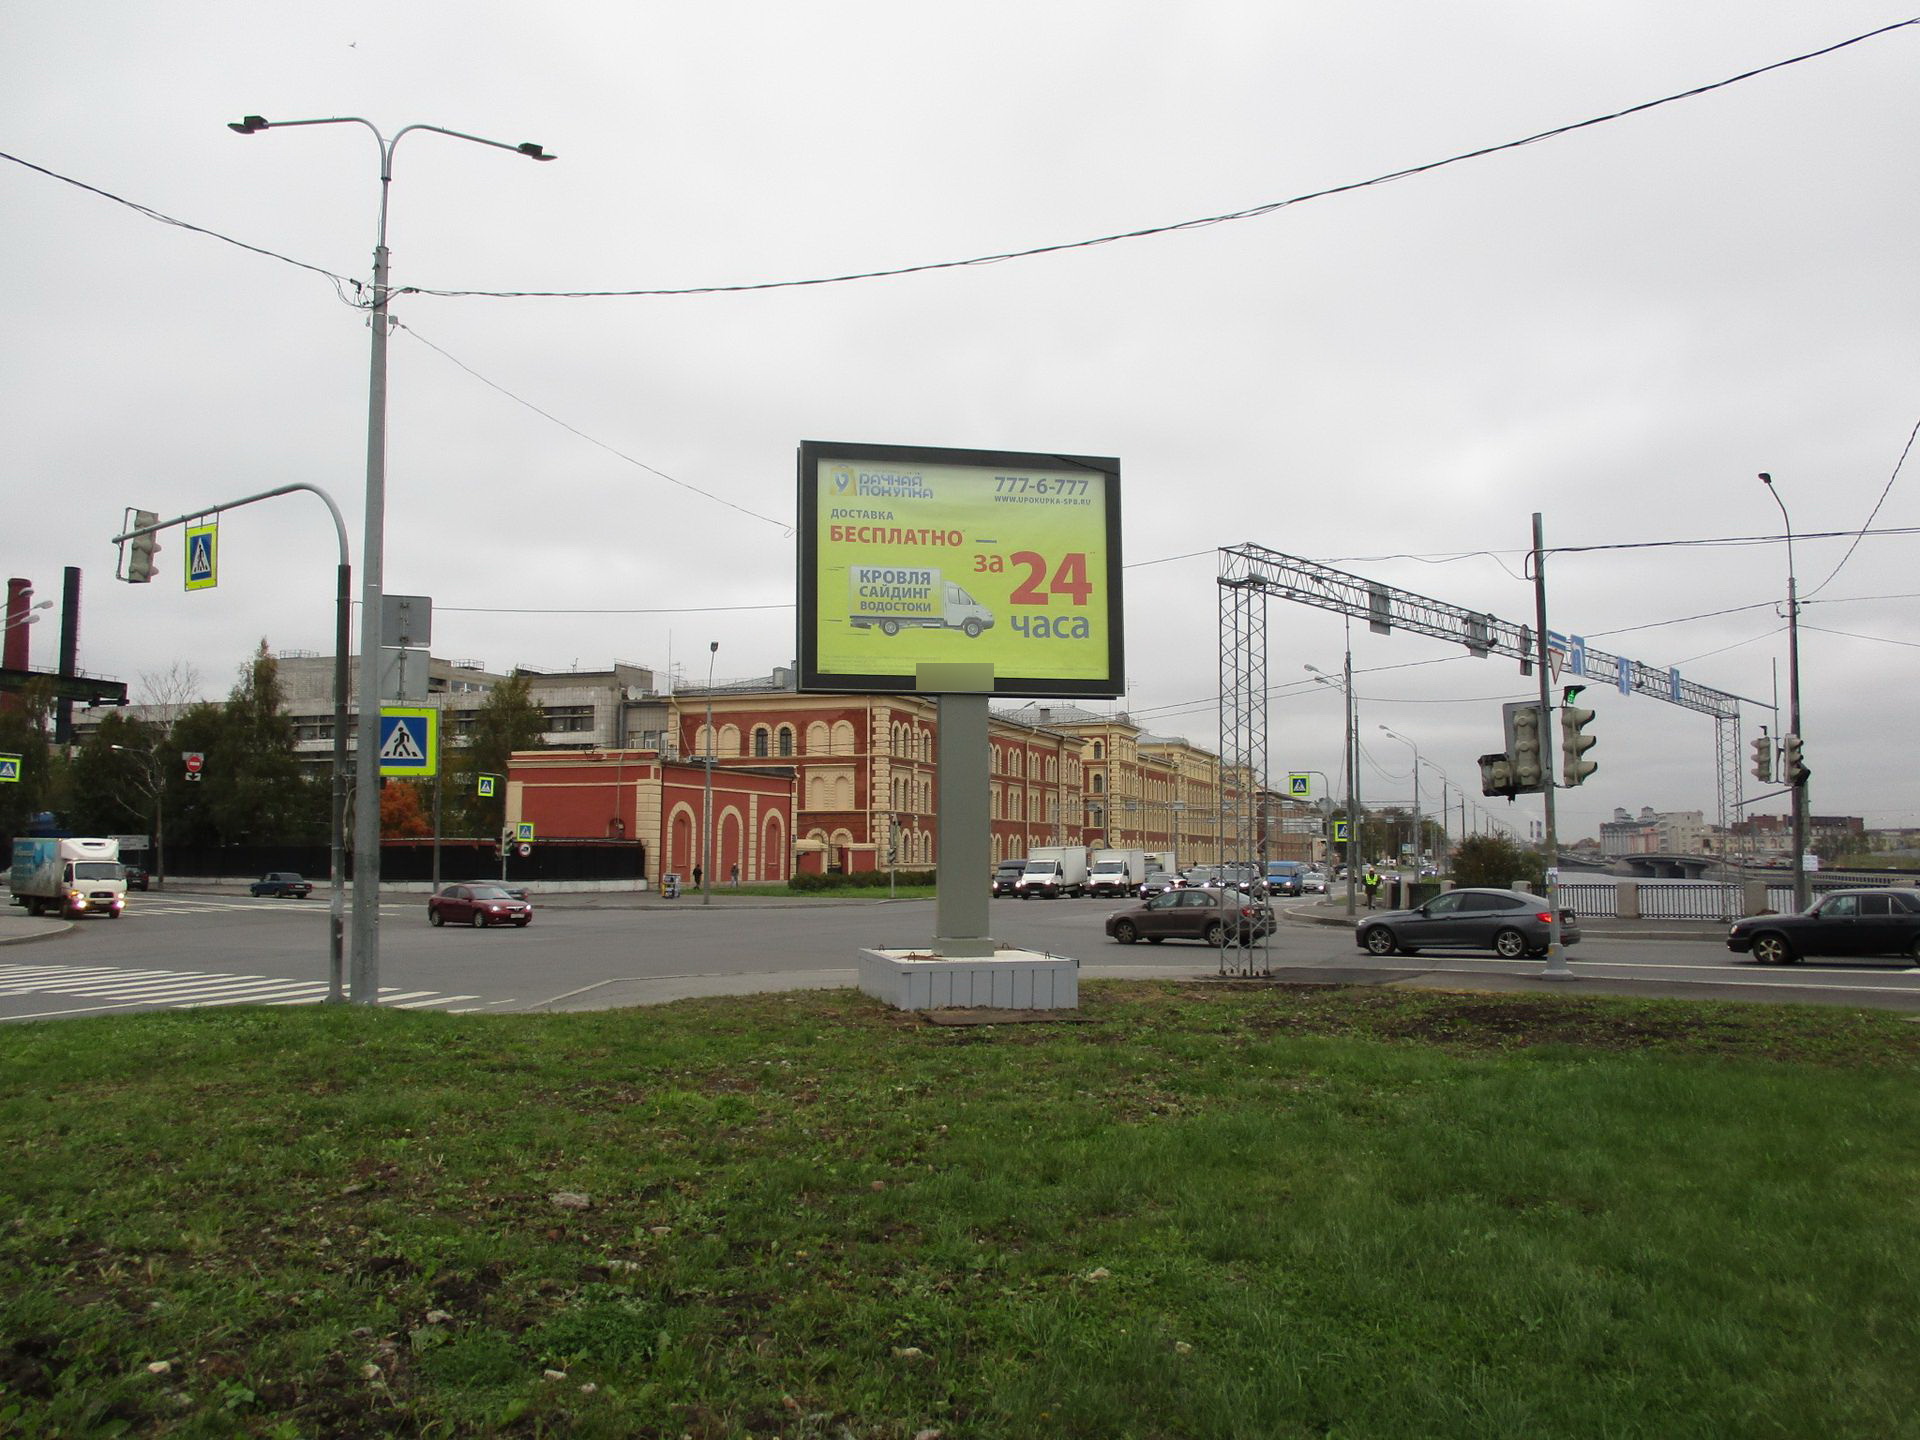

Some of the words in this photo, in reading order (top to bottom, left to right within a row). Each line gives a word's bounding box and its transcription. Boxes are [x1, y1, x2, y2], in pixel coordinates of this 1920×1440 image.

[995, 476, 1089, 496] 777-6-777
[995, 495, 1091, 505] WWW.UPOKUPKA-SPB.RU
[831, 508, 894, 520] ДОСТАВКА
[860, 570, 931, 585] КРОВЛЯ
[974, 554, 1003, 573] за
[1010, 551, 1093, 606] 24
[859, 583, 932, 600] САЙДИНГ
[860, 601, 931, 613] ВОДОСТОКИ
[1010, 615, 1090, 639] часа
